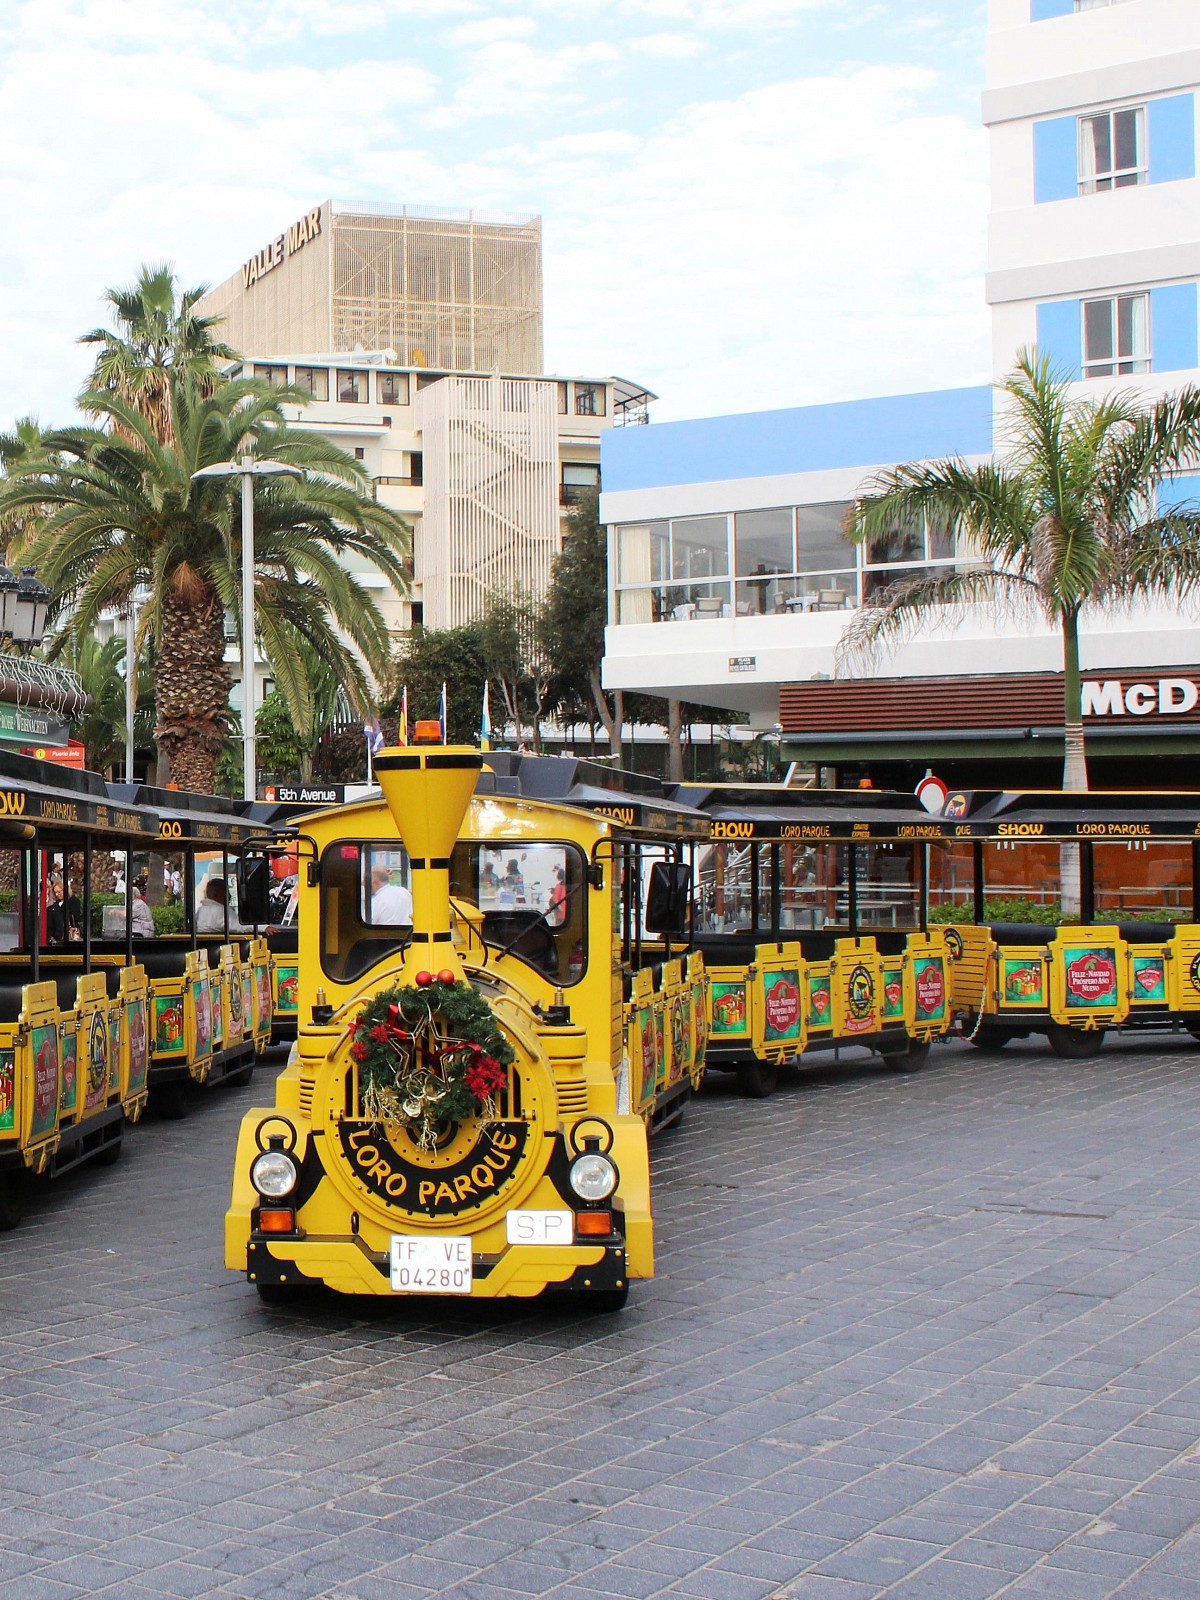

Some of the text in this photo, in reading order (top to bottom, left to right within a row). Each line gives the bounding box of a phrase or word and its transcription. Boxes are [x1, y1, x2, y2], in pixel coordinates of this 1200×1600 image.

[242, 207, 321, 288] VALLE MAR
[16, 711, 48, 735] WEIHNACHTEN
[279, 788, 337, 801] 5th Avenue
[40, 801, 78, 821] LORO PARQUE
[780, 825, 831, 838] LORO PARQUE
[897, 825, 942, 837] LORO PARQUE
[955, 825, 971, 836] QUE
[997, 823, 1044, 836] SHOW
[1076, 823, 1151, 835] LORO PARQUE
[348, 1129, 518, 1206] LORO PARQUE
[395, 1241, 467, 1262] TF VE
[399, 1267, 464, 1287] 04280
